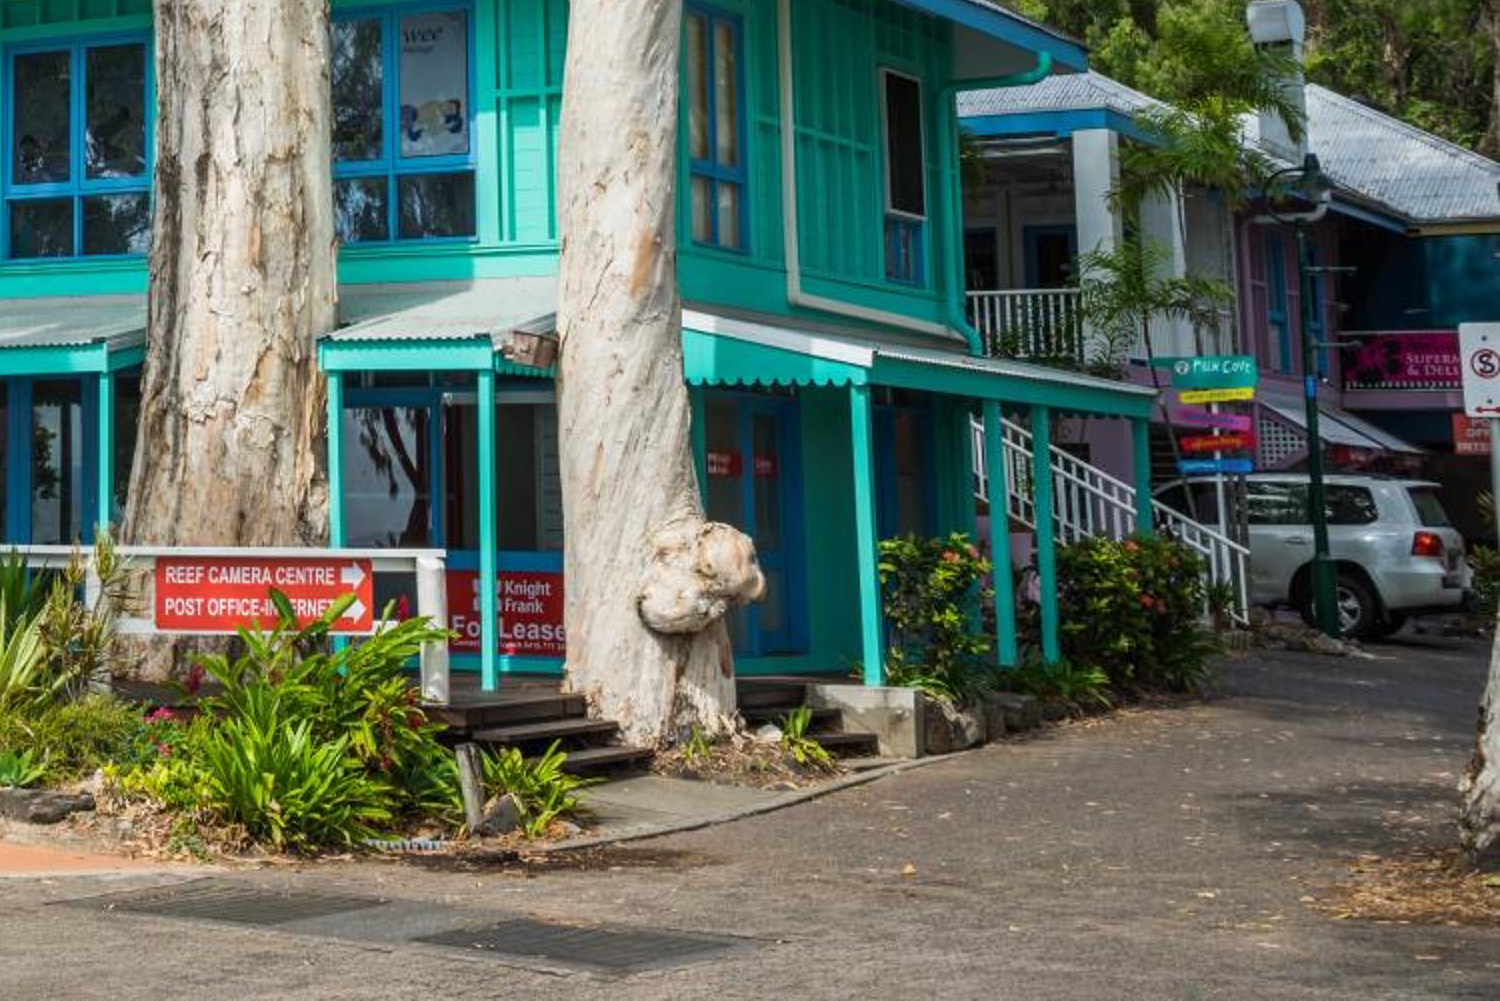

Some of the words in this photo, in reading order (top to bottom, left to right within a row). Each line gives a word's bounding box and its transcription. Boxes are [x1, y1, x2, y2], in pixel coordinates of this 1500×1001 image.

[165, 566, 203, 584] REEF
[207, 566, 272, 585] CAMERA
[275, 566, 335, 585] CENTRE
[504, 580, 552, 599] Knight
[165, 598, 203, 616] POST
[504, 598, 545, 614] Frank
[451, 615, 481, 638] Fo
[499, 615, 565, 640] Lease
